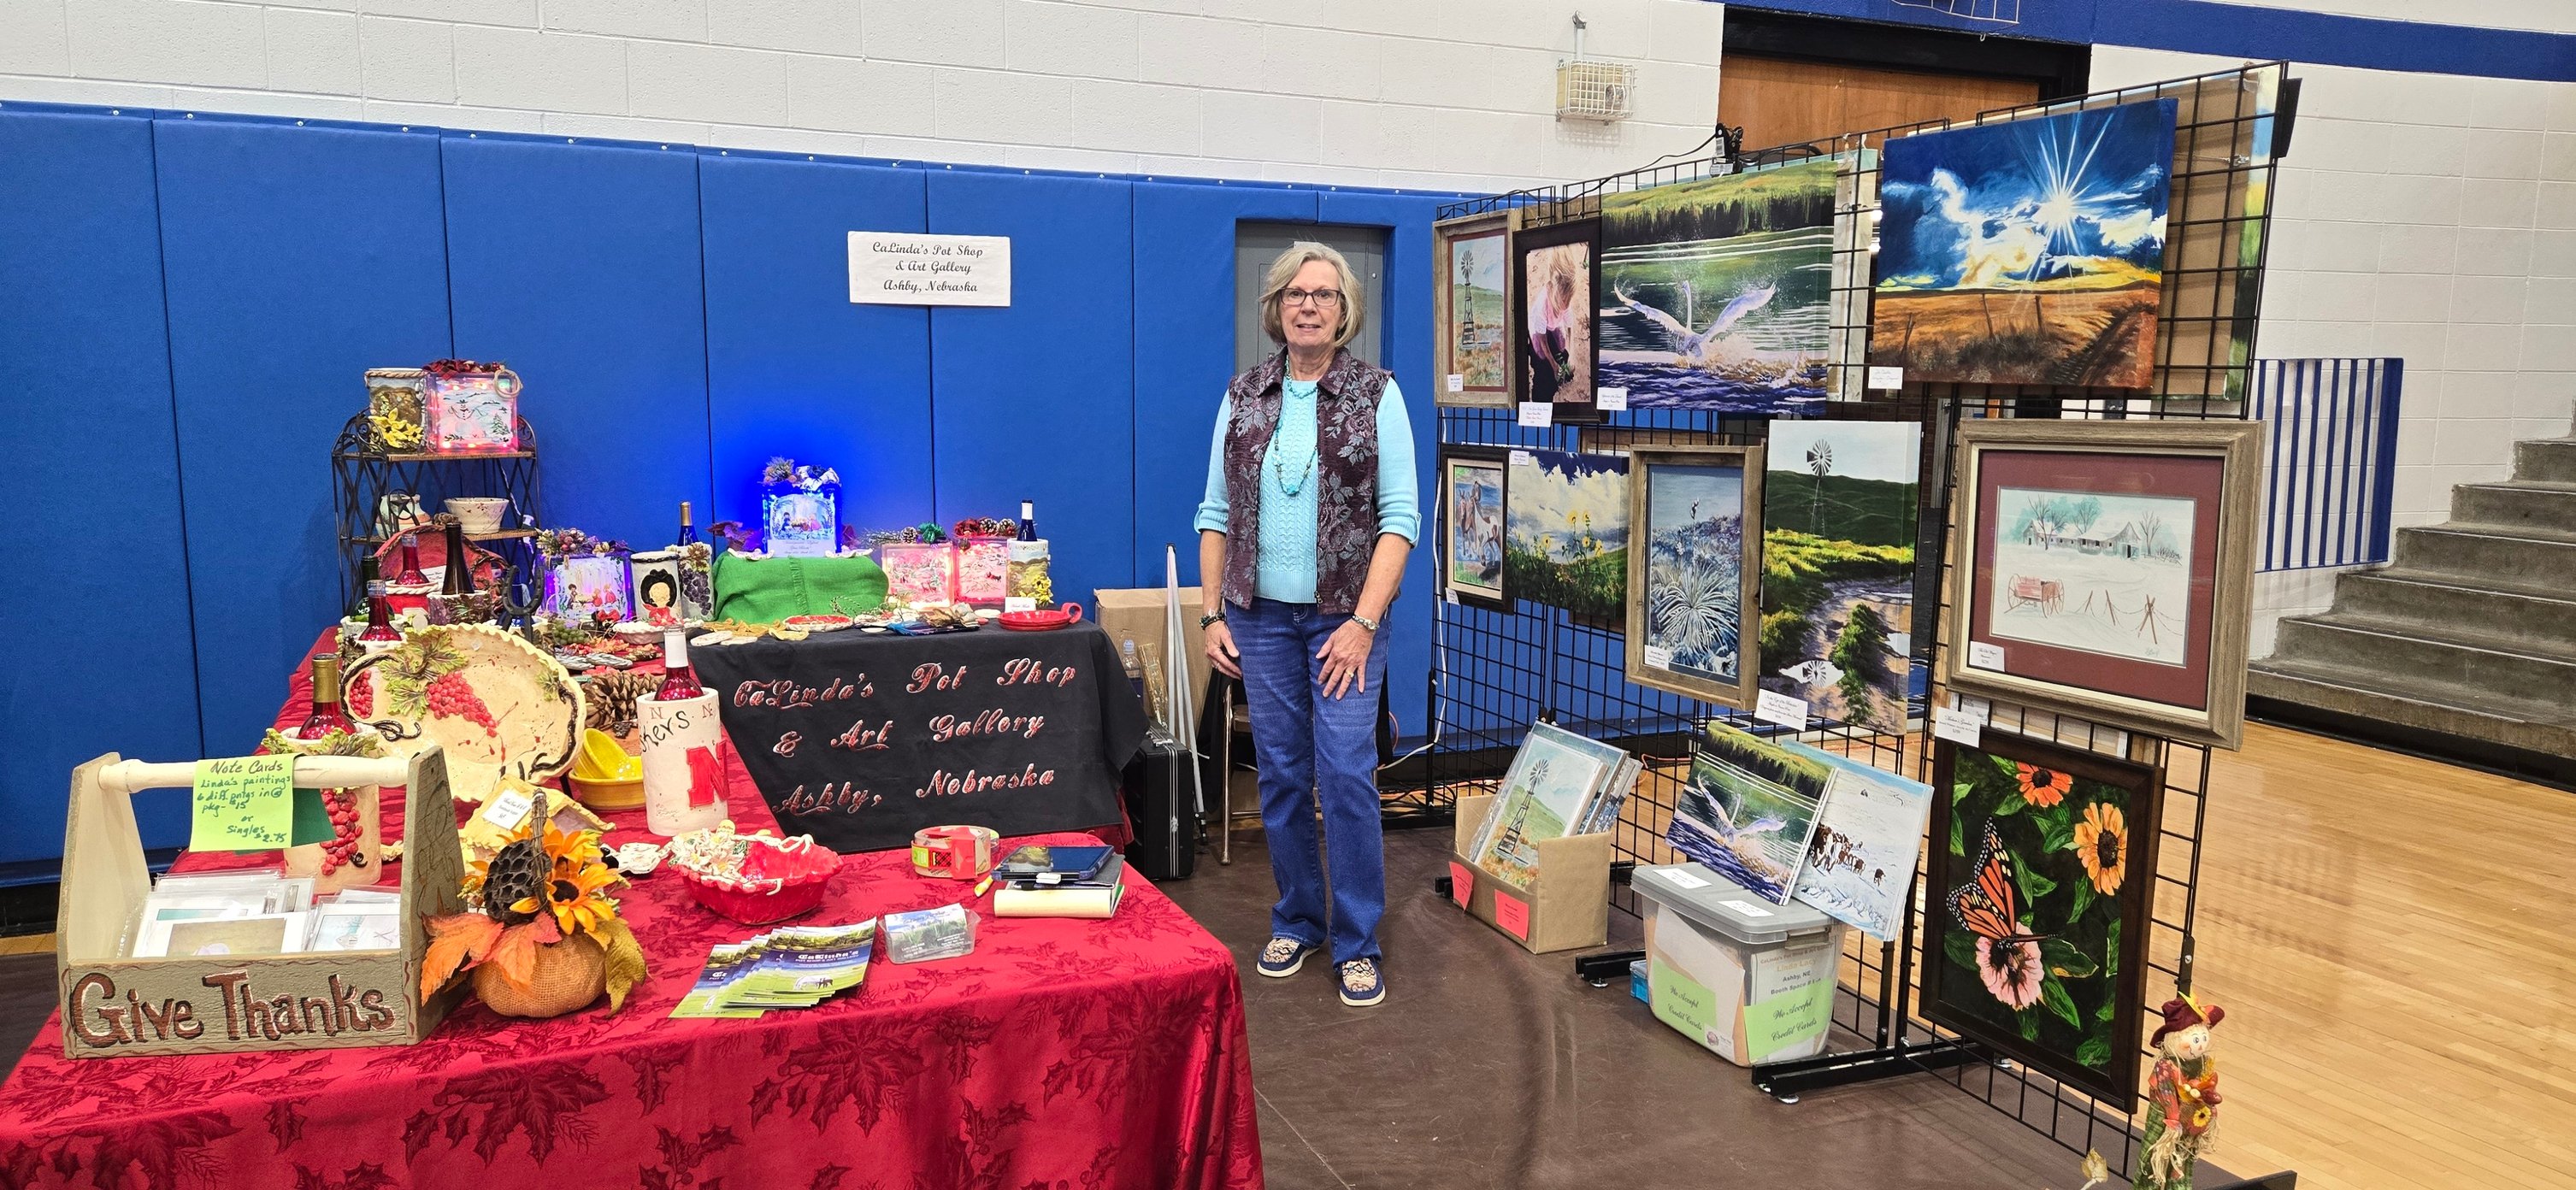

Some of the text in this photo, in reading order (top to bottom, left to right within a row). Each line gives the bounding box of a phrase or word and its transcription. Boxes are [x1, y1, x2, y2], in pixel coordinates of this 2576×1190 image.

[872, 241, 983, 258] CaLinda's Pot Shop
[895, 261, 972, 275] & Art Gallery
[883, 280, 978, 294] Ashby, Nebraska
[734, 657, 1076, 710] CaLinda's Pot Shop
[650, 703, 713, 720] N N
[772, 708, 1045, 757] & Art Gallery
[209, 760, 283, 775] Note Cards
[686, 739, 730, 808] N
[201, 774, 291, 792] Linda's paintings
[771, 763, 1055, 816] Ashby, Nebraska
[227, 824, 265, 838] Singles
[1777, 962, 1798, 972] Linda
[1771, 987, 1788, 995] Booth
[70, 969, 397, 1050] Give Thanks
[1787, 997, 1813, 1016] Accept
[1686, 1014, 1702, 1030] Cards
[1771, 1017, 1817, 1042] Credit Cards
